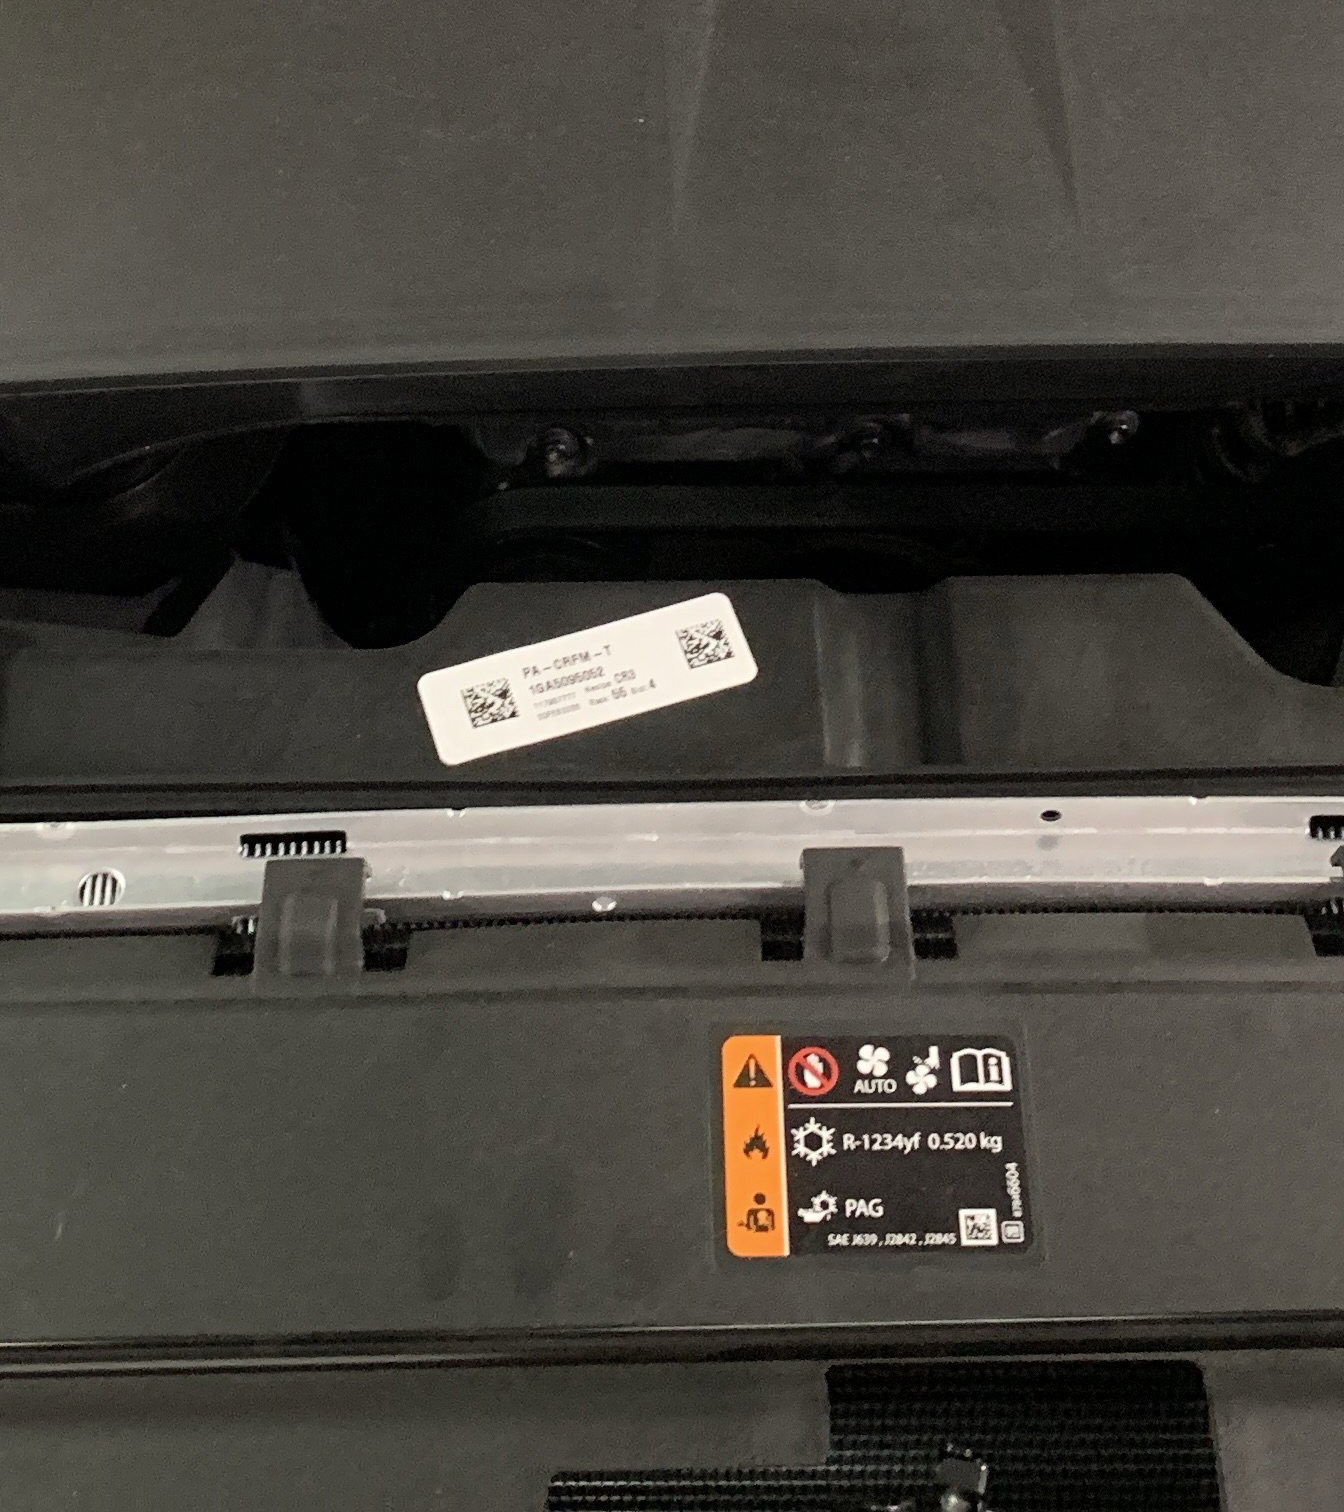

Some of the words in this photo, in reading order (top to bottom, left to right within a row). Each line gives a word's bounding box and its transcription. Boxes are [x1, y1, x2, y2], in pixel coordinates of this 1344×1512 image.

[854, 1078, 898, 1094] AUTO
[842, 1131, 922, 1155] R-1234yf
[927, 1132, 978, 1151] 0.520
[979, 1131, 1003, 1153] kg
[844, 1198, 885, 1218] PAG
[827, 1233, 850, 1247] SAE
